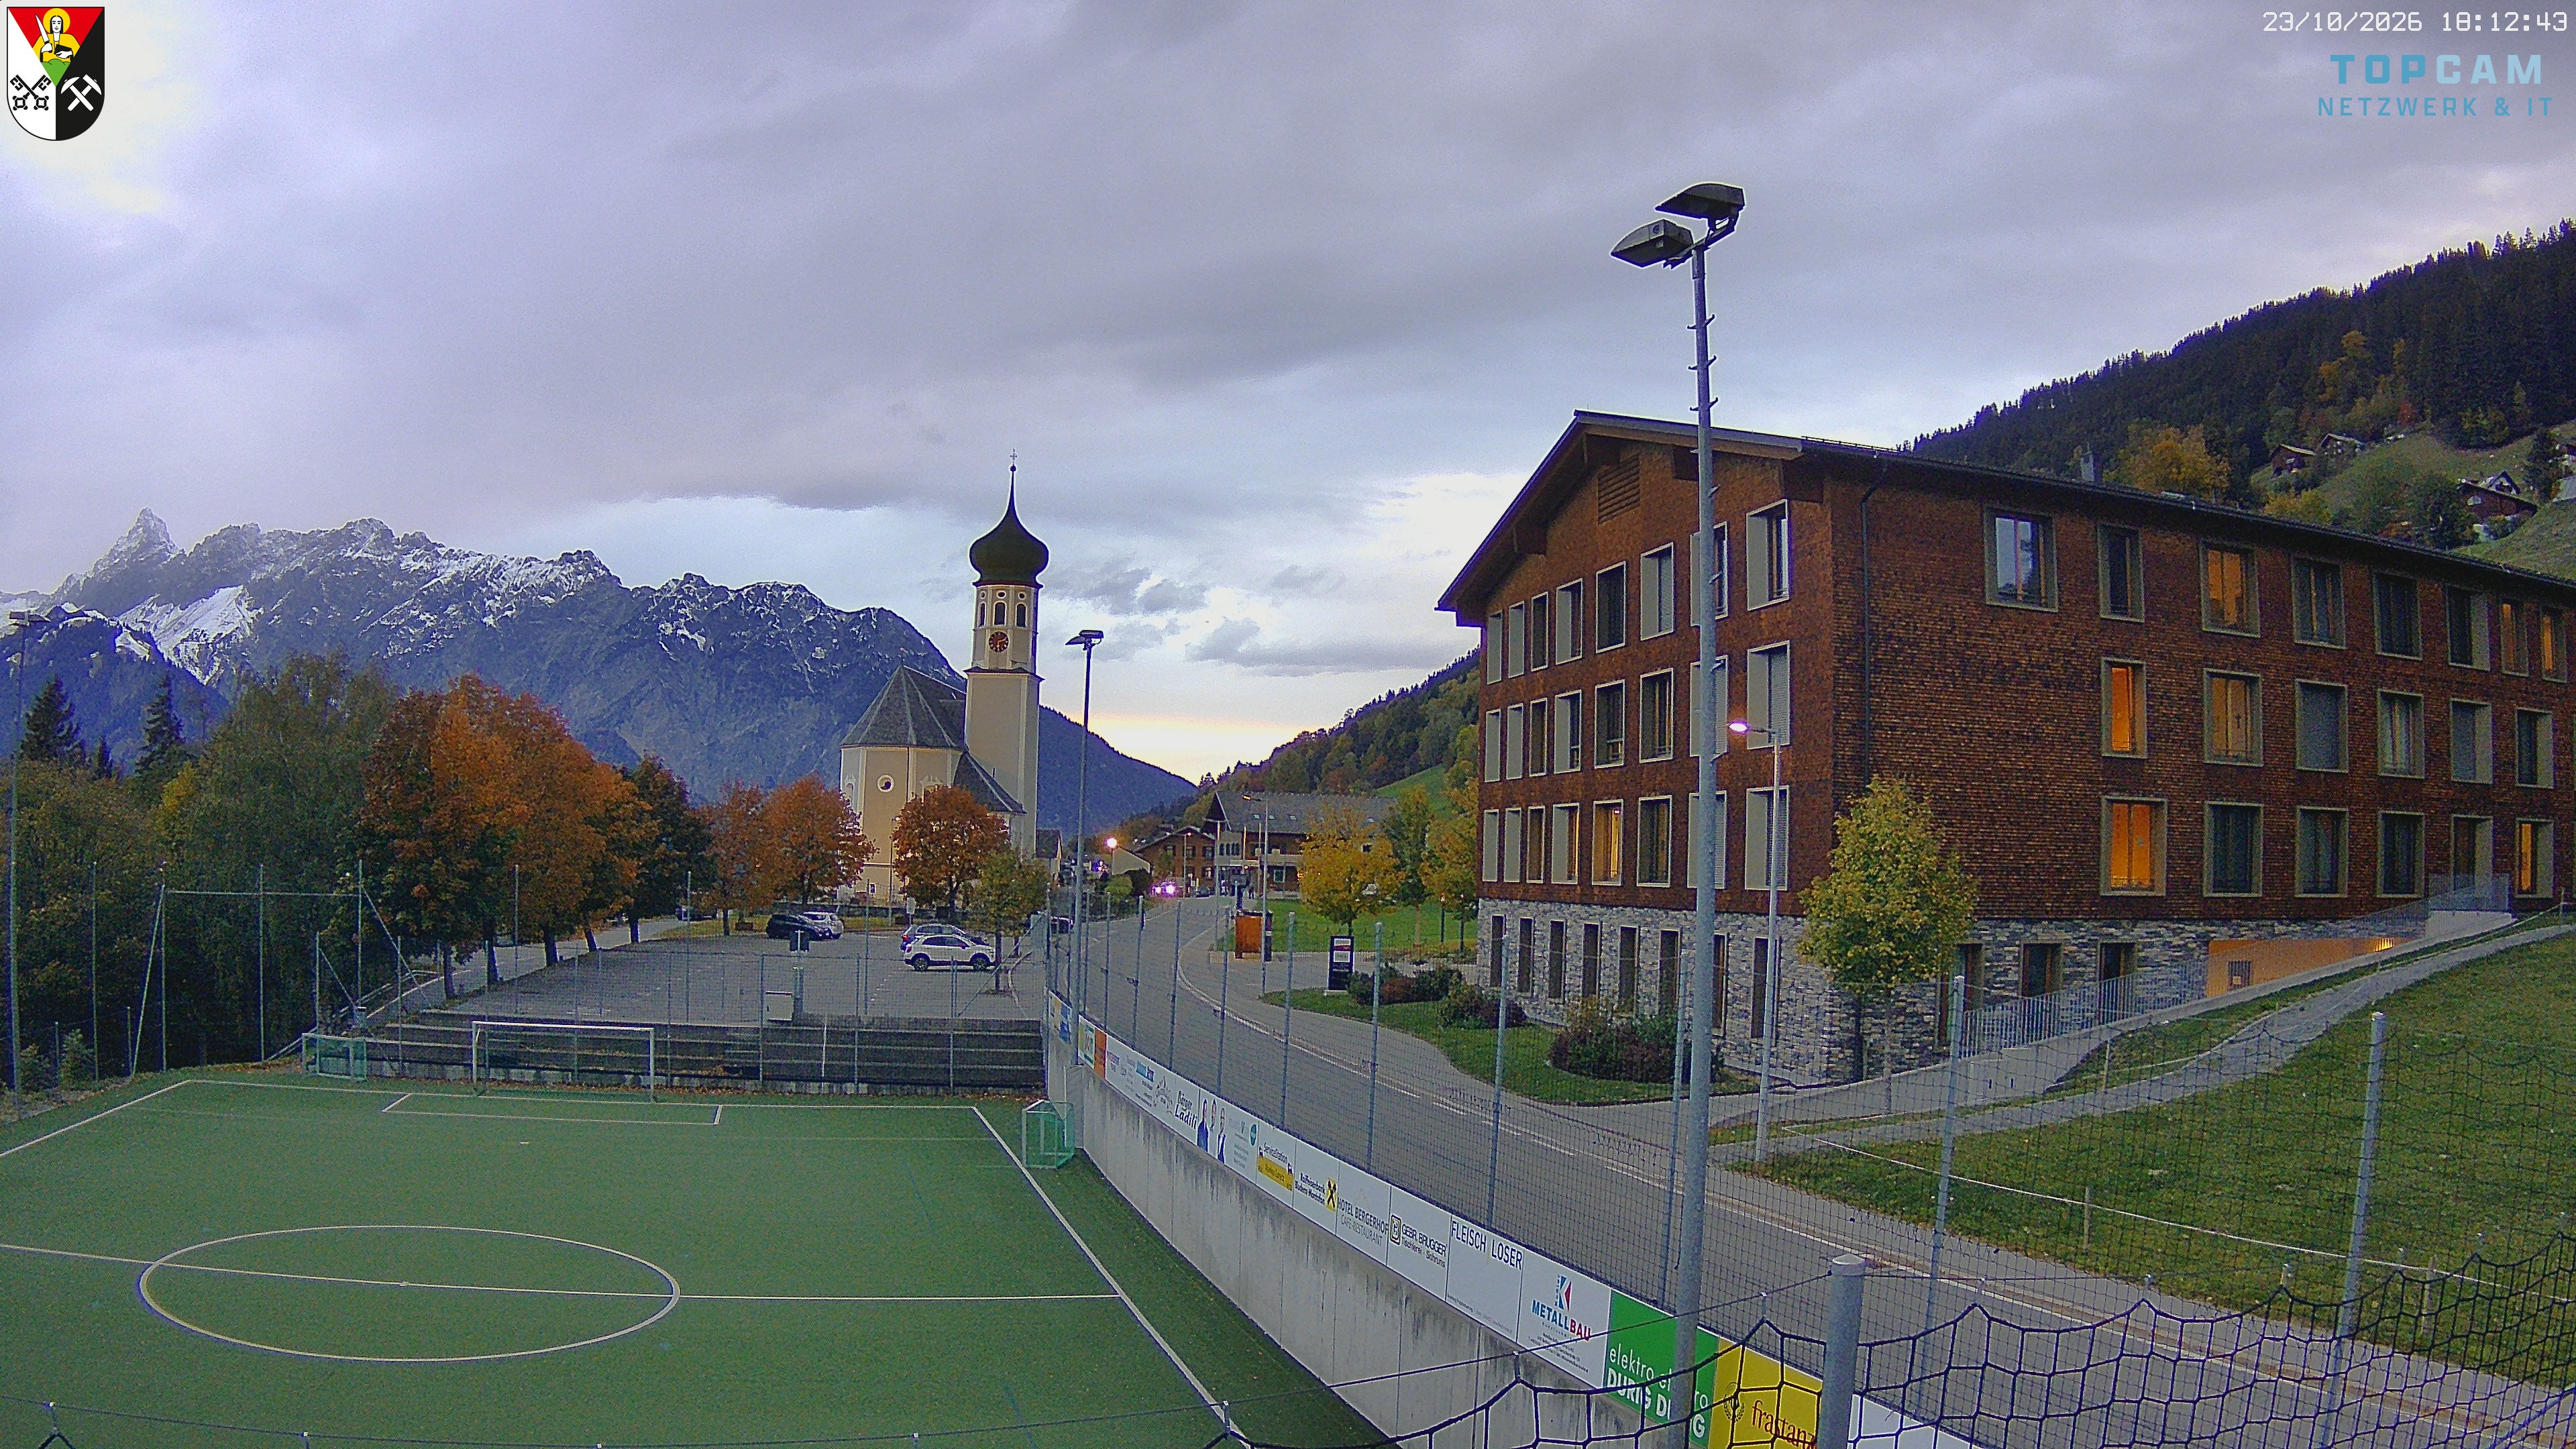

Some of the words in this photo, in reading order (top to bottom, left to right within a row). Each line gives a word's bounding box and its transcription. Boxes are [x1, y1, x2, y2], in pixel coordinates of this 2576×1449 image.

[1338, 1197, 1354, 1216] HOTEL
[1355, 1207, 1389, 1235] BERGERHOF
[1451, 1220, 1487, 1253] FLEISCH
[1491, 1239, 1523, 1271] LOSER
[1609, 1343, 1654, 1381] elektro
